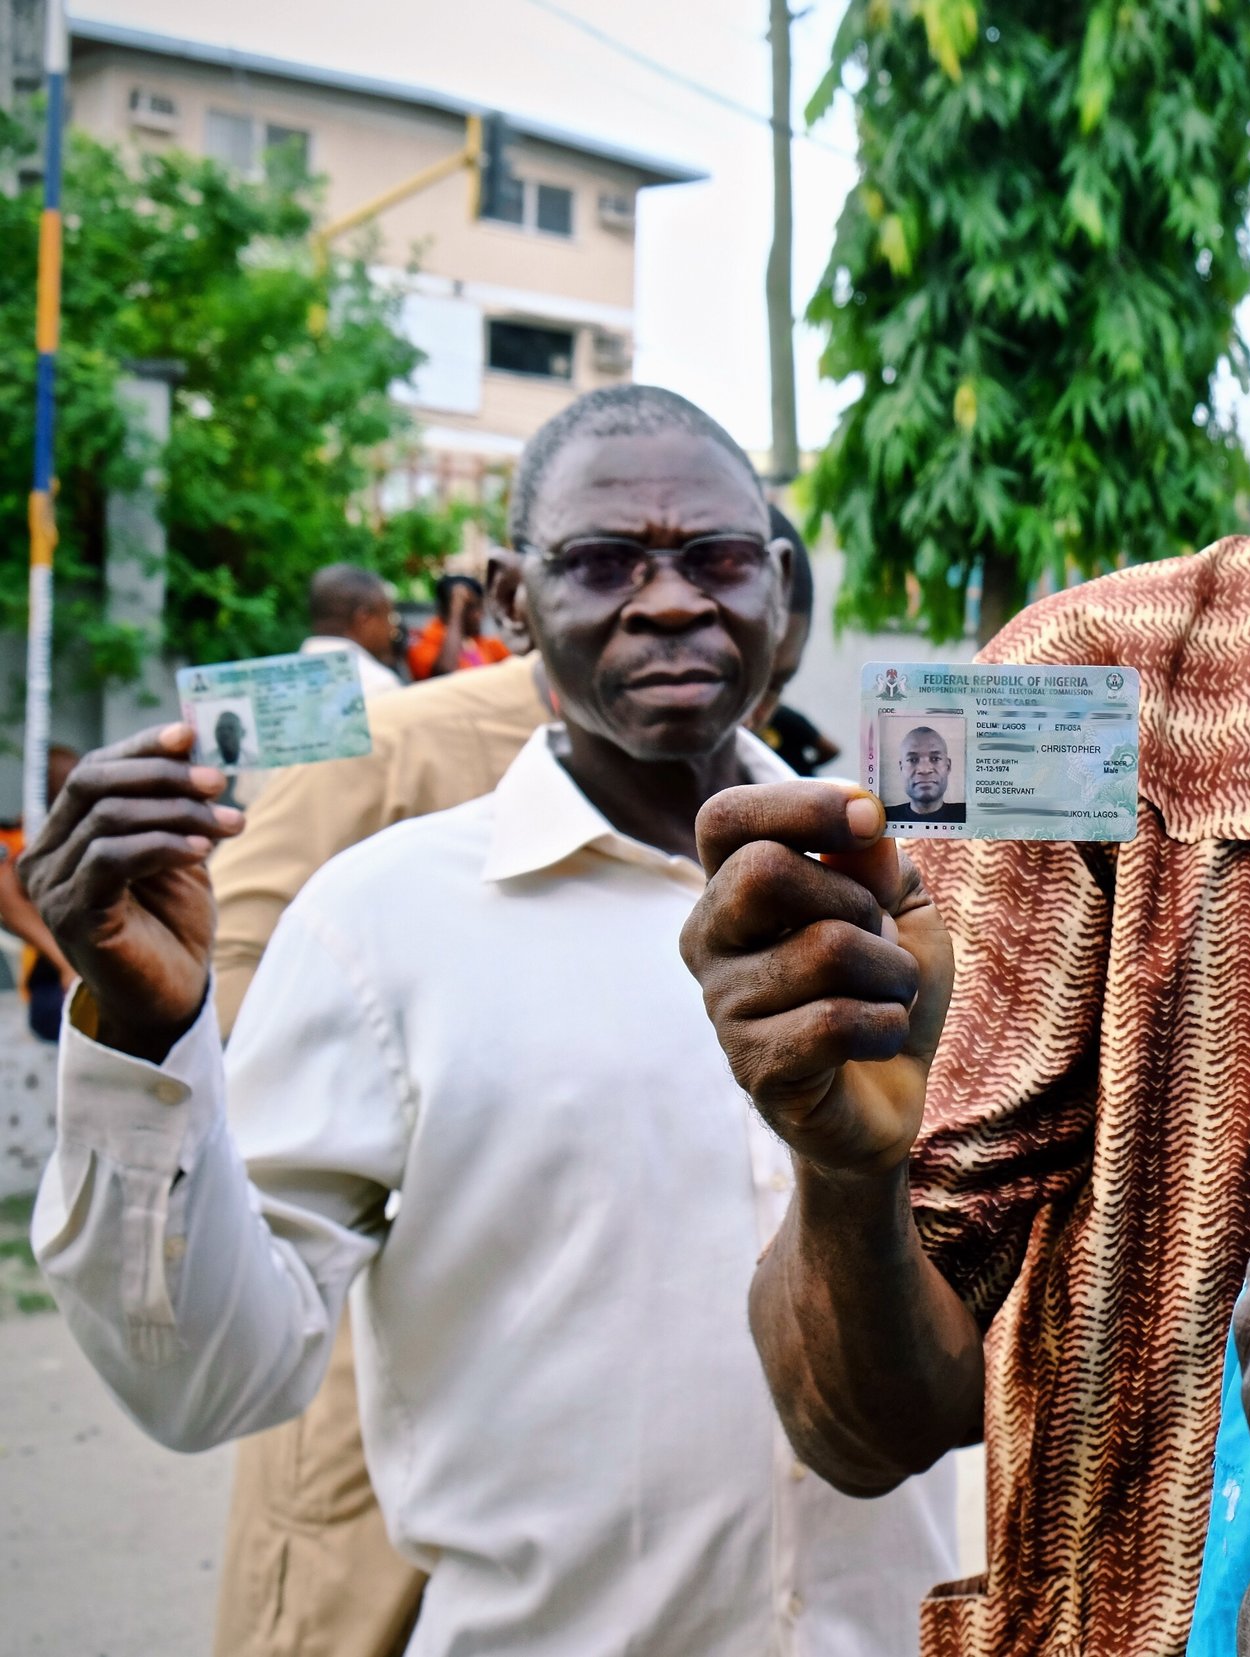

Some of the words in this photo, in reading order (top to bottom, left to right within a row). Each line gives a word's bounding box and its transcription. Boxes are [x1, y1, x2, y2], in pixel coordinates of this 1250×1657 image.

[923, 674, 970, 686] FEDERAL
[973, 675, 1024, 687] REPUBLIC
[1027, 676, 1041, 687] OF
[1044, 676, 1089, 688] NIGERIA
[919, 686, 967, 694] INDEPENDENT
[970, 687, 1005, 695] NATIONAL
[1009, 687, 1045, 695] ELECTORAL
[1049, 688, 1094, 696] COMMISSION
[1002, 723, 1026, 731] LAGOS
[1041, 744, 1102, 754] CHRISTOPHER
[975, 786, 1001, 795] PUBLIC
[1001, 787, 1035, 795] SERVANT
[1093, 811, 1118, 819] LAGOS
